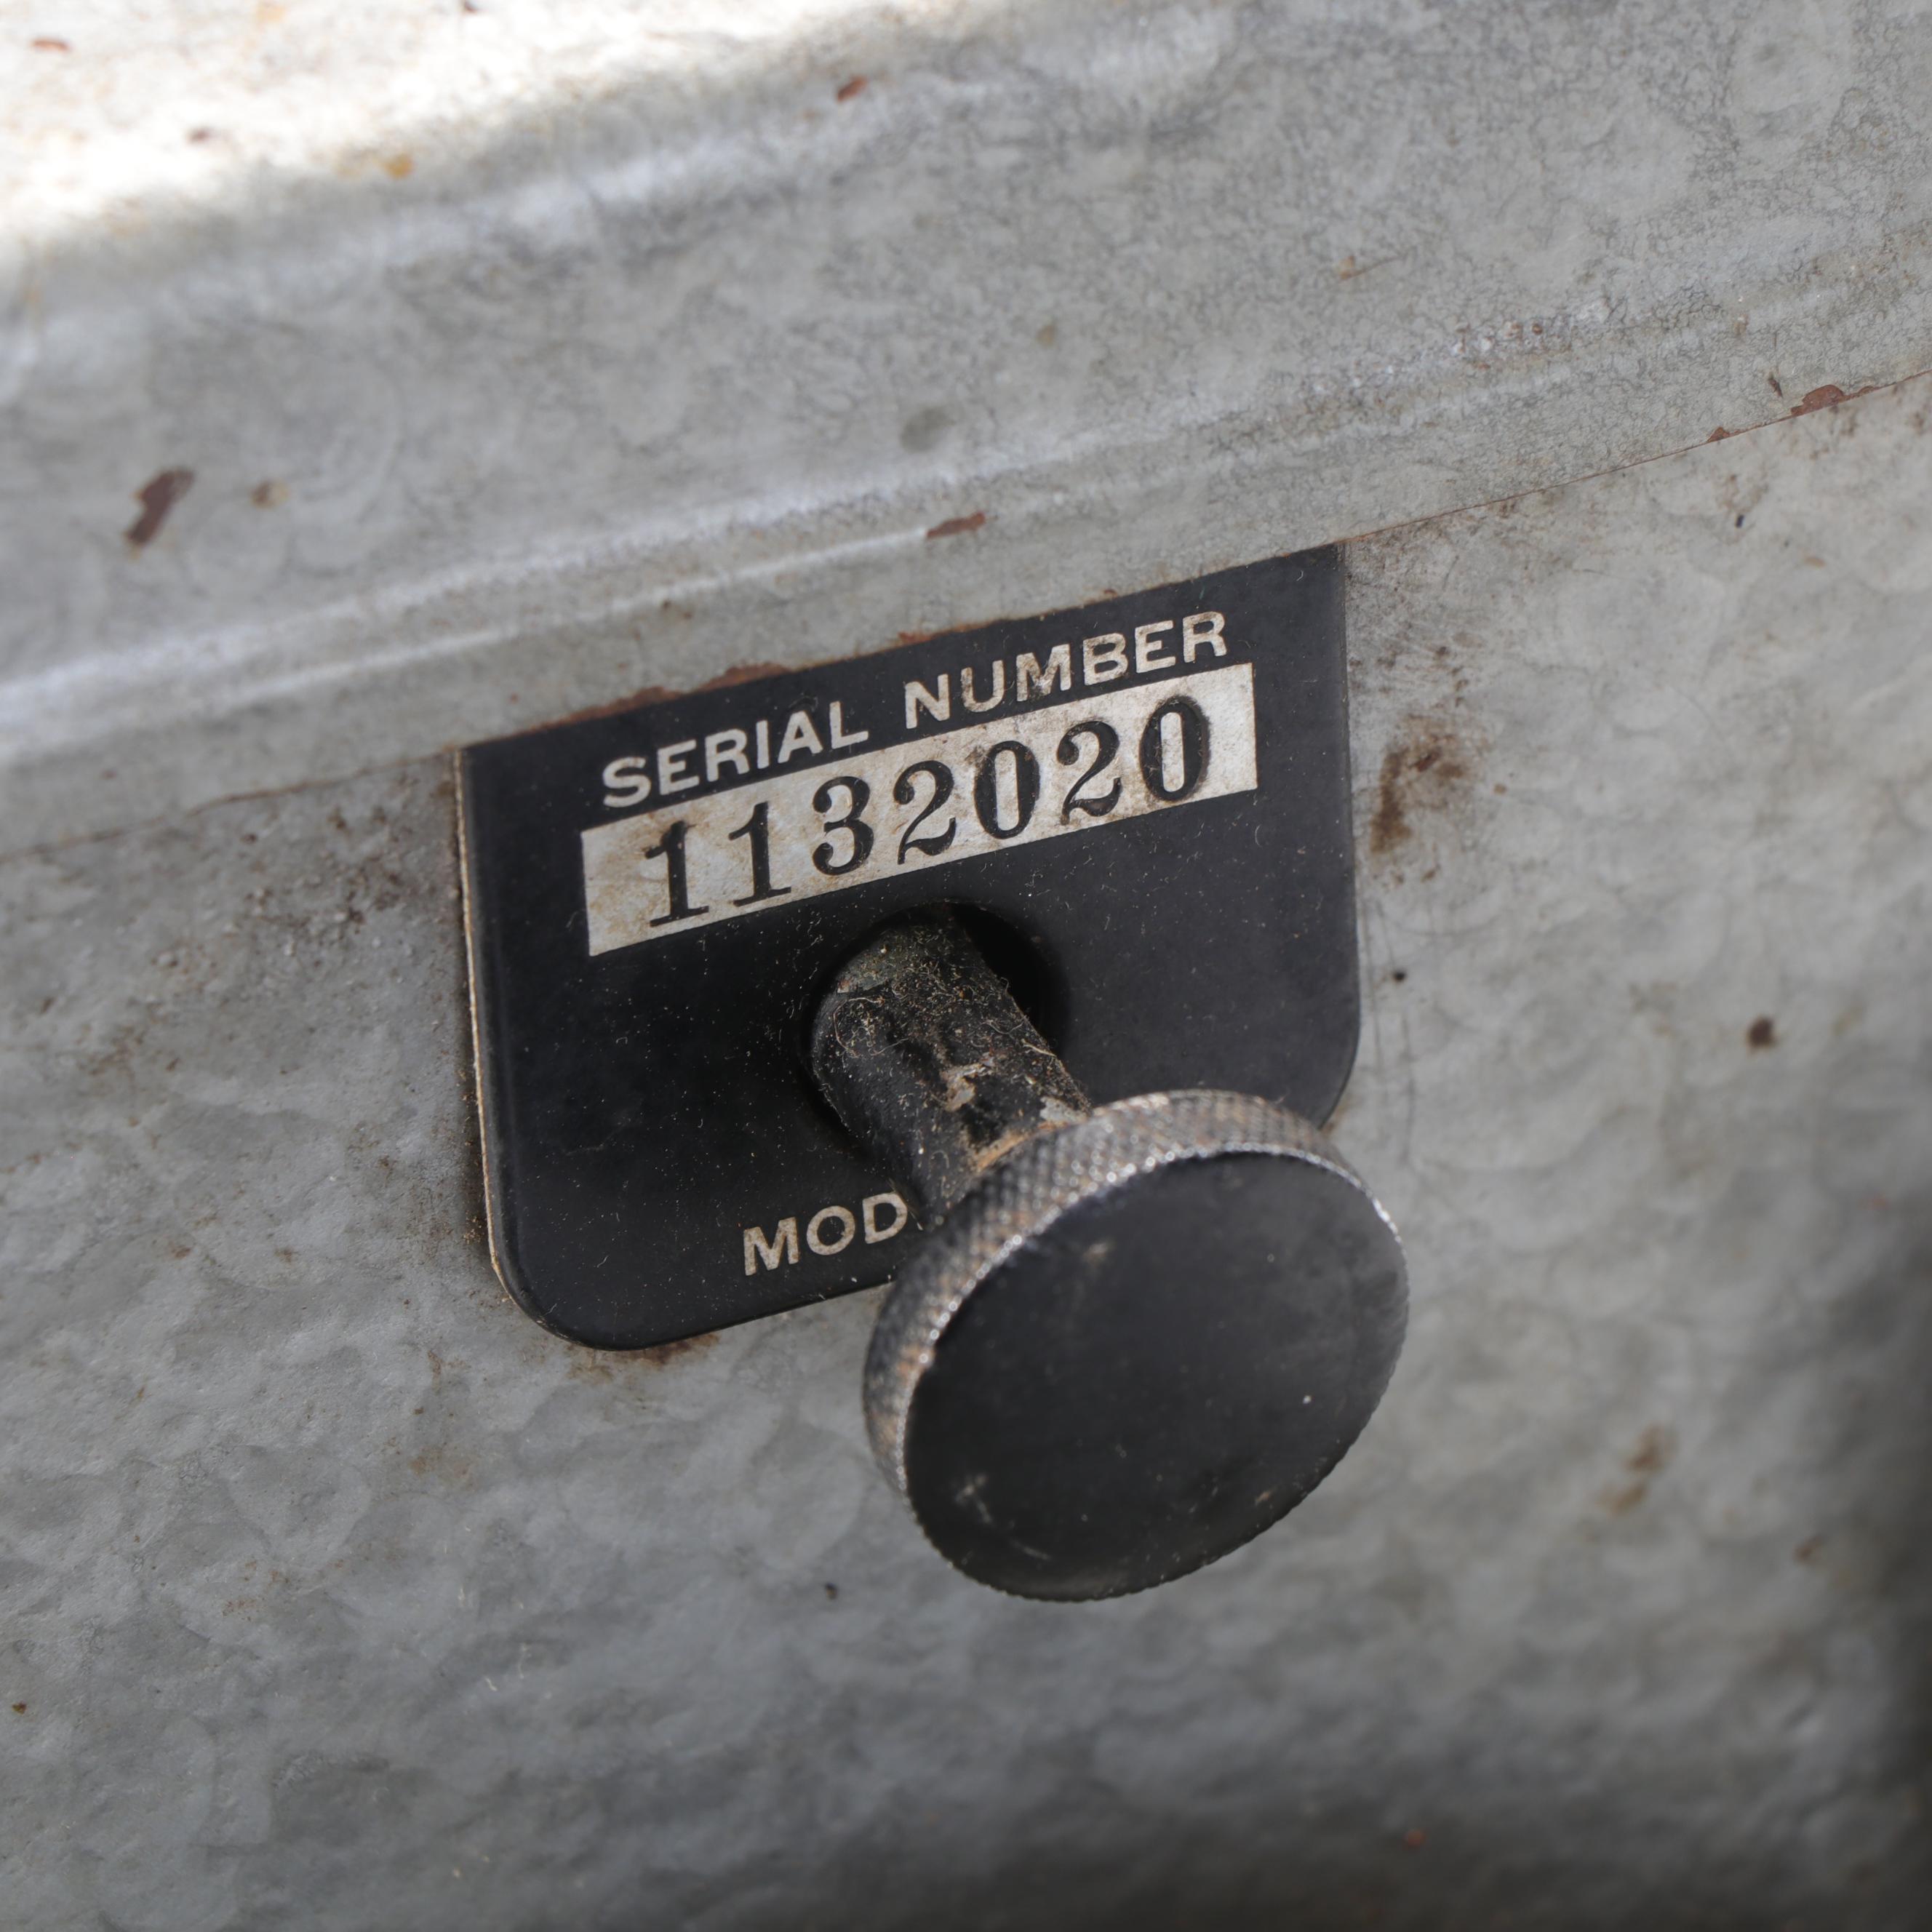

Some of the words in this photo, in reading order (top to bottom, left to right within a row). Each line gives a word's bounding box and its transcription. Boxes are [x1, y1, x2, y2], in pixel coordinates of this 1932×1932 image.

[603, 700, 870, 807] SERIAL
[904, 611, 1228, 730] NUMBER
[642, 695, 1210, 928] 1132020
